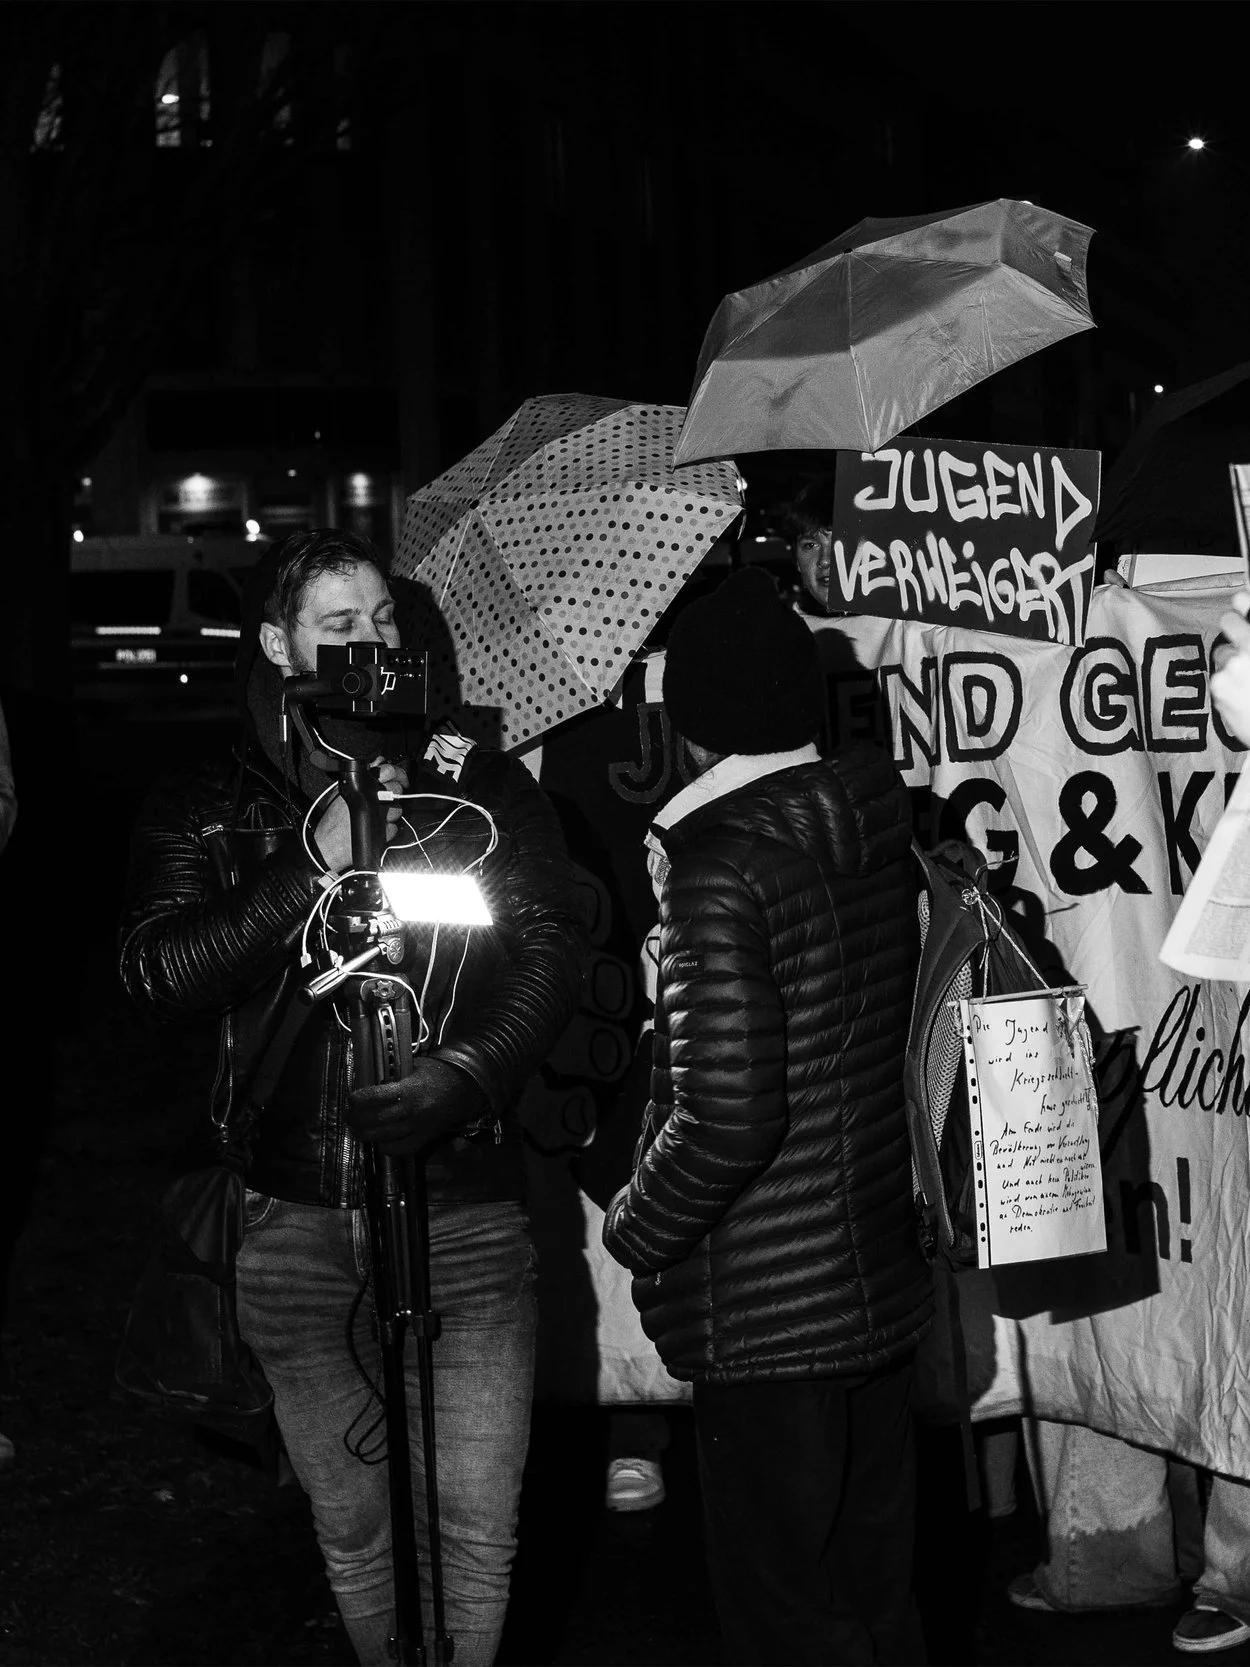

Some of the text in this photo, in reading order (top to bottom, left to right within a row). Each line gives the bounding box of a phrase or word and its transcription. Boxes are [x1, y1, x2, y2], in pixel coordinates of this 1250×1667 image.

[853, 448, 1093, 551] JUGEND
[972, 1015, 1048, 1045] Die Jugend
[988, 1050, 1039, 1065] wird ins
[1023, 1121, 1043, 1134] Ende
[1047, 1120, 1062, 1133] wird
[989, 1139, 1042, 1158] Bevölkerung
[996, 1157, 1014, 1170] und
[1001, 1178, 1021, 1190] Und
[1025, 1174, 1043, 1186] auch
[1000, 1193, 1021, 1206] wird
[1011, 1203, 1059, 1219] Demokratie
